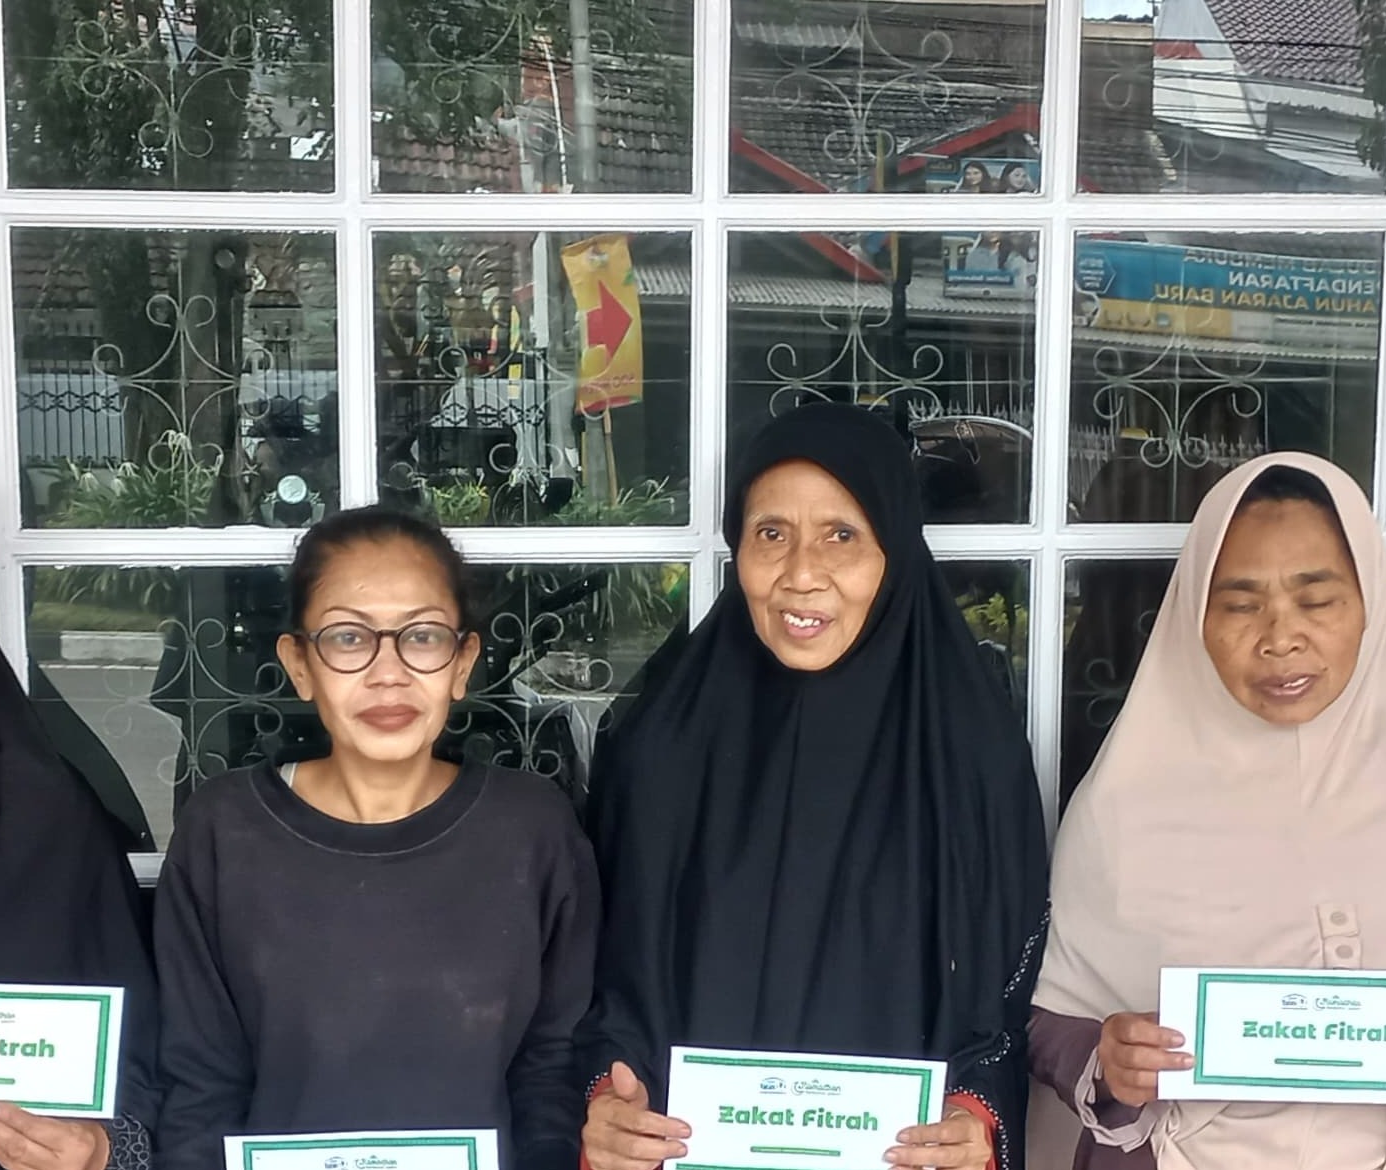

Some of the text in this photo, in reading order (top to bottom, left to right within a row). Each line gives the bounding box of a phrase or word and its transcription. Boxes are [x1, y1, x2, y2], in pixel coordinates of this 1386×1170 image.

[1242, 1020, 1316, 1040] Zakat
[718, 1105, 878, 1130] Zakat Fitrah
